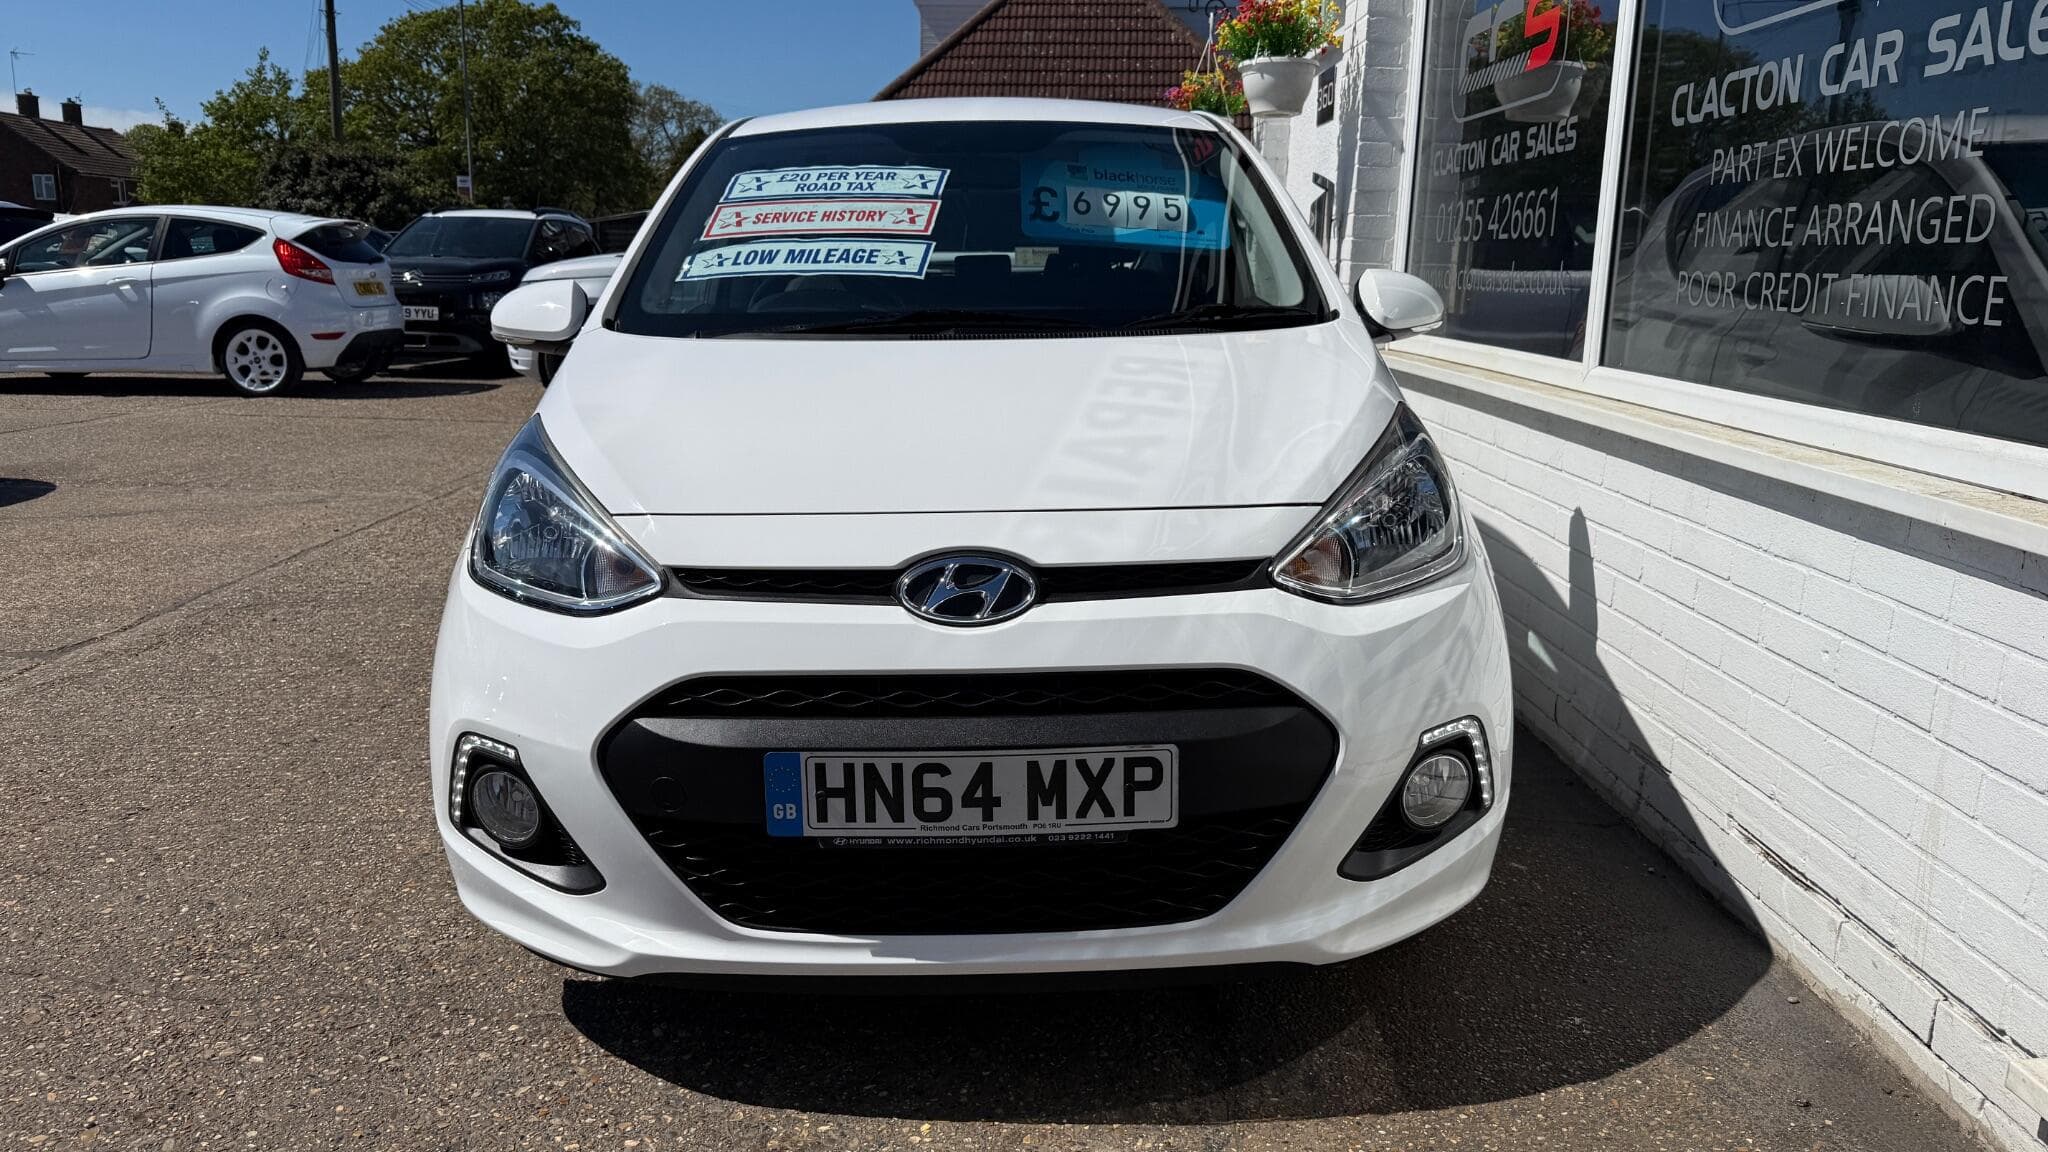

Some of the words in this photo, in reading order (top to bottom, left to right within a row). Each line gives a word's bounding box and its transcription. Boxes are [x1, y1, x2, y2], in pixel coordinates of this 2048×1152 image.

[1671, 54, 1804, 127] CLACTON
[1819, 29, 1904, 97] CAR
[1318, 79, 1334, 112] 360
[1433, 138, 1487, 177] CLACTON
[1491, 130, 1521, 168] CAR
[1525, 115, 1578, 160] SALES
[1711, 141, 1767, 186] PART
[1773, 136, 1804, 179] EX
[1814, 106, 1990, 175] WELCOME
[778, 171, 811, 183] £20
[816, 171, 849, 182] PER
[852, 170, 897, 182] YEAR
[794, 180, 843, 193] ROAD
[846, 180, 876, 193] TAX
[752, 211, 819, 225] SERVICE
[820, 208, 888, 223] HISTORY
[1436, 198, 1484, 243] 01255
[1488, 185, 1559, 241] 426661
[1694, 206, 1797, 248] FINANCE
[1802, 193, 1997, 246] ARRANGED
[731, 250, 779, 267] LOW
[783, 248, 882, 265] MILEAGE
[1676, 270, 1737, 310] POOR
[1743, 272, 1837, 315] CREDIT
[1845, 275, 2008, 327] FINANCE
[414, 308, 434, 318] YYU
[814, 762, 1001, 824] HN64
[1026, 756, 1163, 820] MXP
[773, 803, 797, 820] GB
[887, 835, 1037, 845] www.richmondhyundai.co.uk
[920, 823, 957, 832] Richmond
[961, 823, 980, 832] Cars
[982, 822, 1028, 832] Portsmouth
